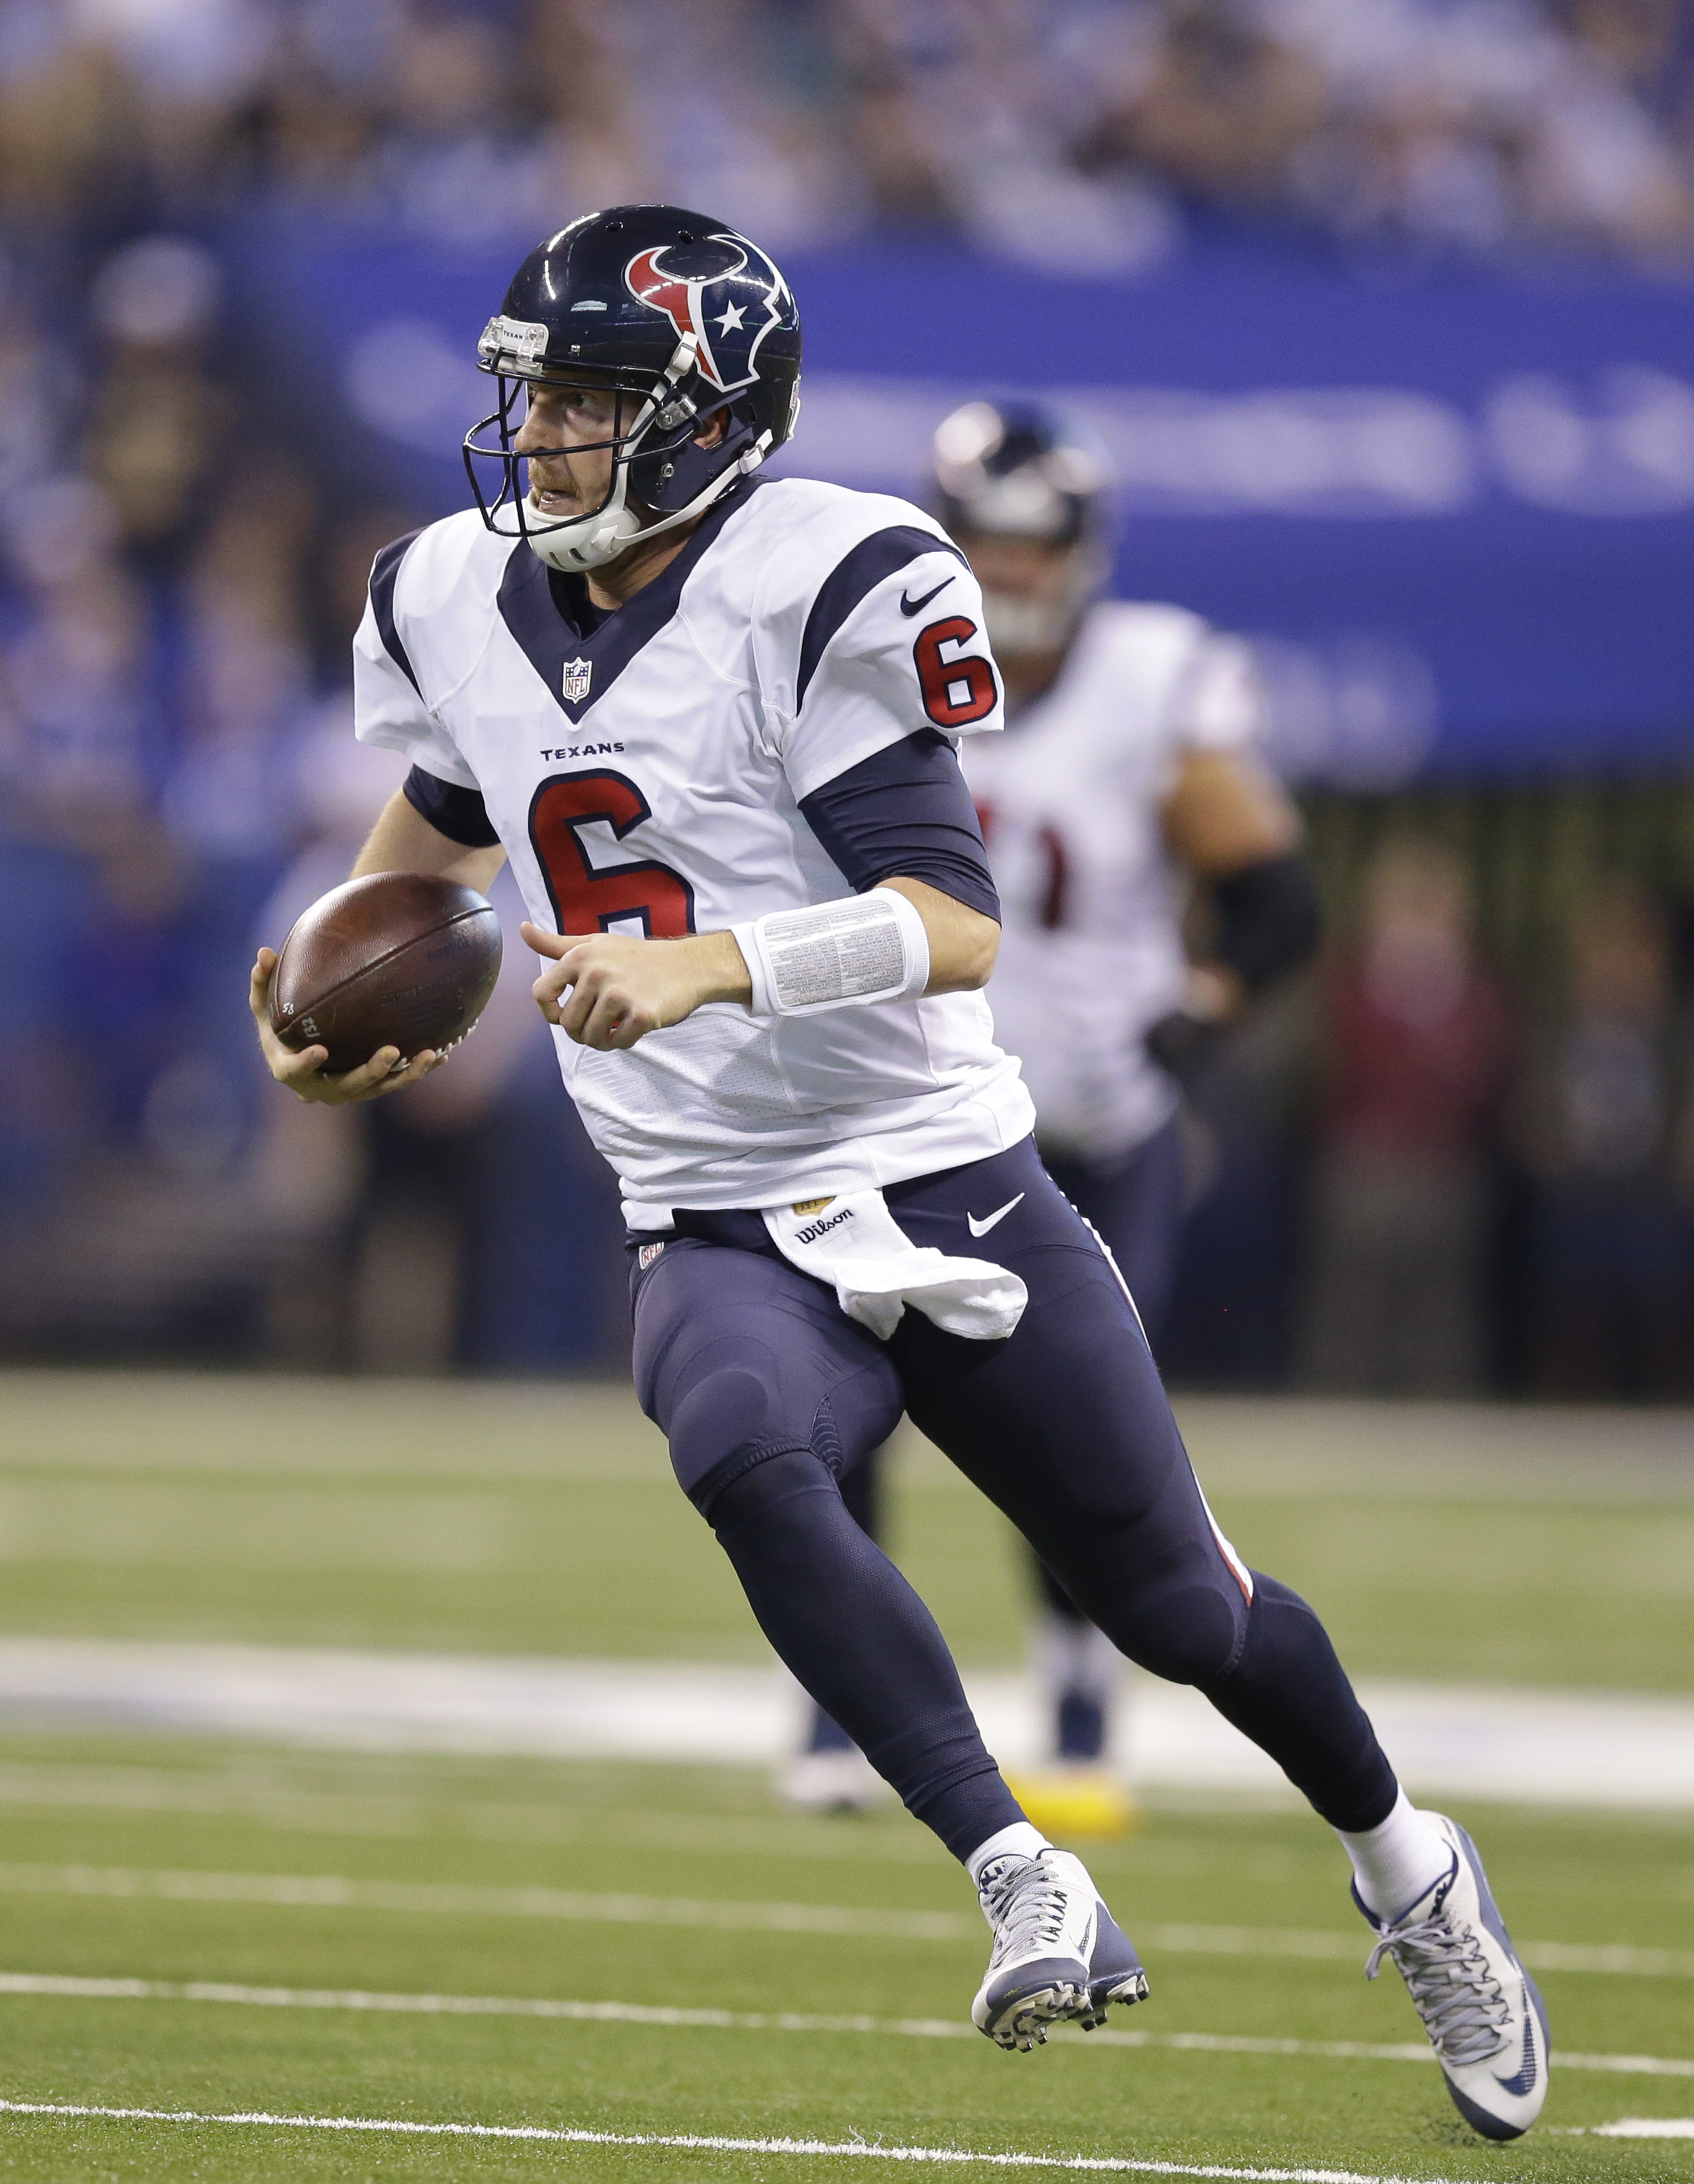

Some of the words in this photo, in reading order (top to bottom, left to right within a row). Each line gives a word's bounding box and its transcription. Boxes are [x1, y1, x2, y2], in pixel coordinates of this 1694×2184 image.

[504, 330, 524, 339] TEXAN
[913, 615, 998, 728] 6
[567, 678, 585, 695] NFL
[539, 742, 625, 762] TEXANS
[527, 767, 697, 940] 6
[282, 1001, 294, 1015] 58
[794, 1209, 855, 1245] Wilson
